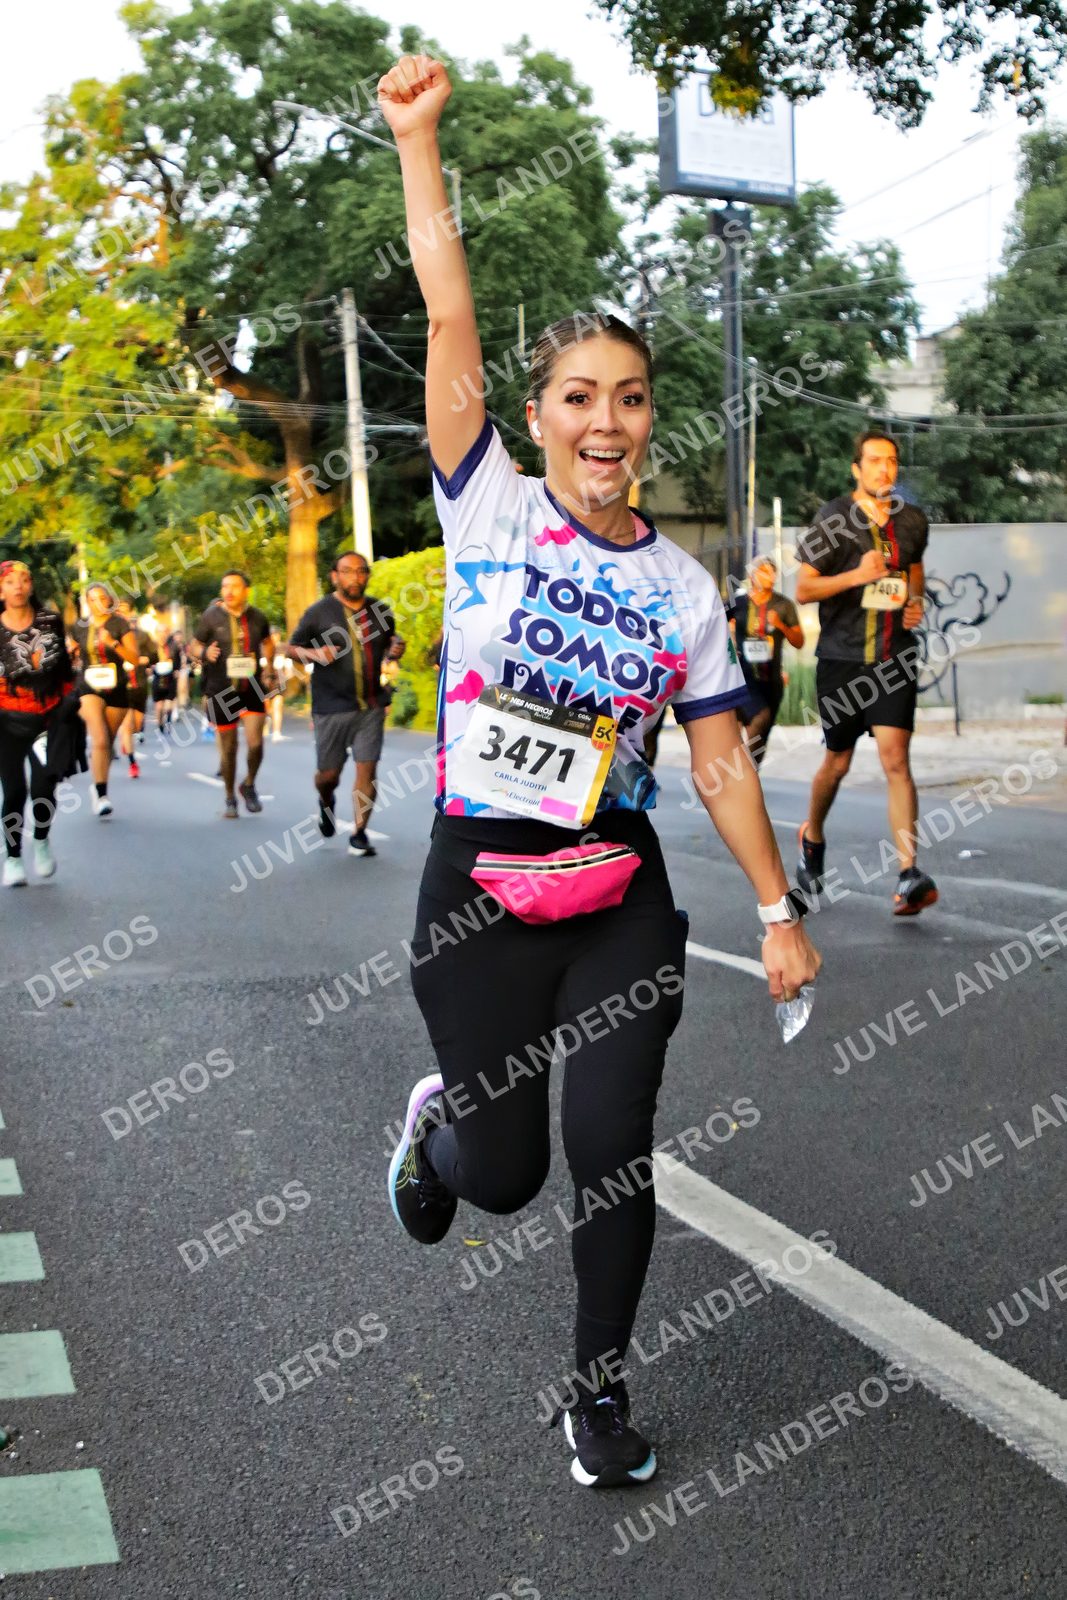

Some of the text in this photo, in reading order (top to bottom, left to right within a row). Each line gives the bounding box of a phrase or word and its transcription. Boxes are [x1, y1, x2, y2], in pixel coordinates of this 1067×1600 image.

[524, 562, 667, 649] TODOS
[500, 609, 668, 700] SOMOS
[524, 701, 554, 716] NEGROS
[478, 725, 576, 783] 3471
[494, 771, 548, 792] CARLA JUDITH
[508, 791, 541, 806] Electrolit
